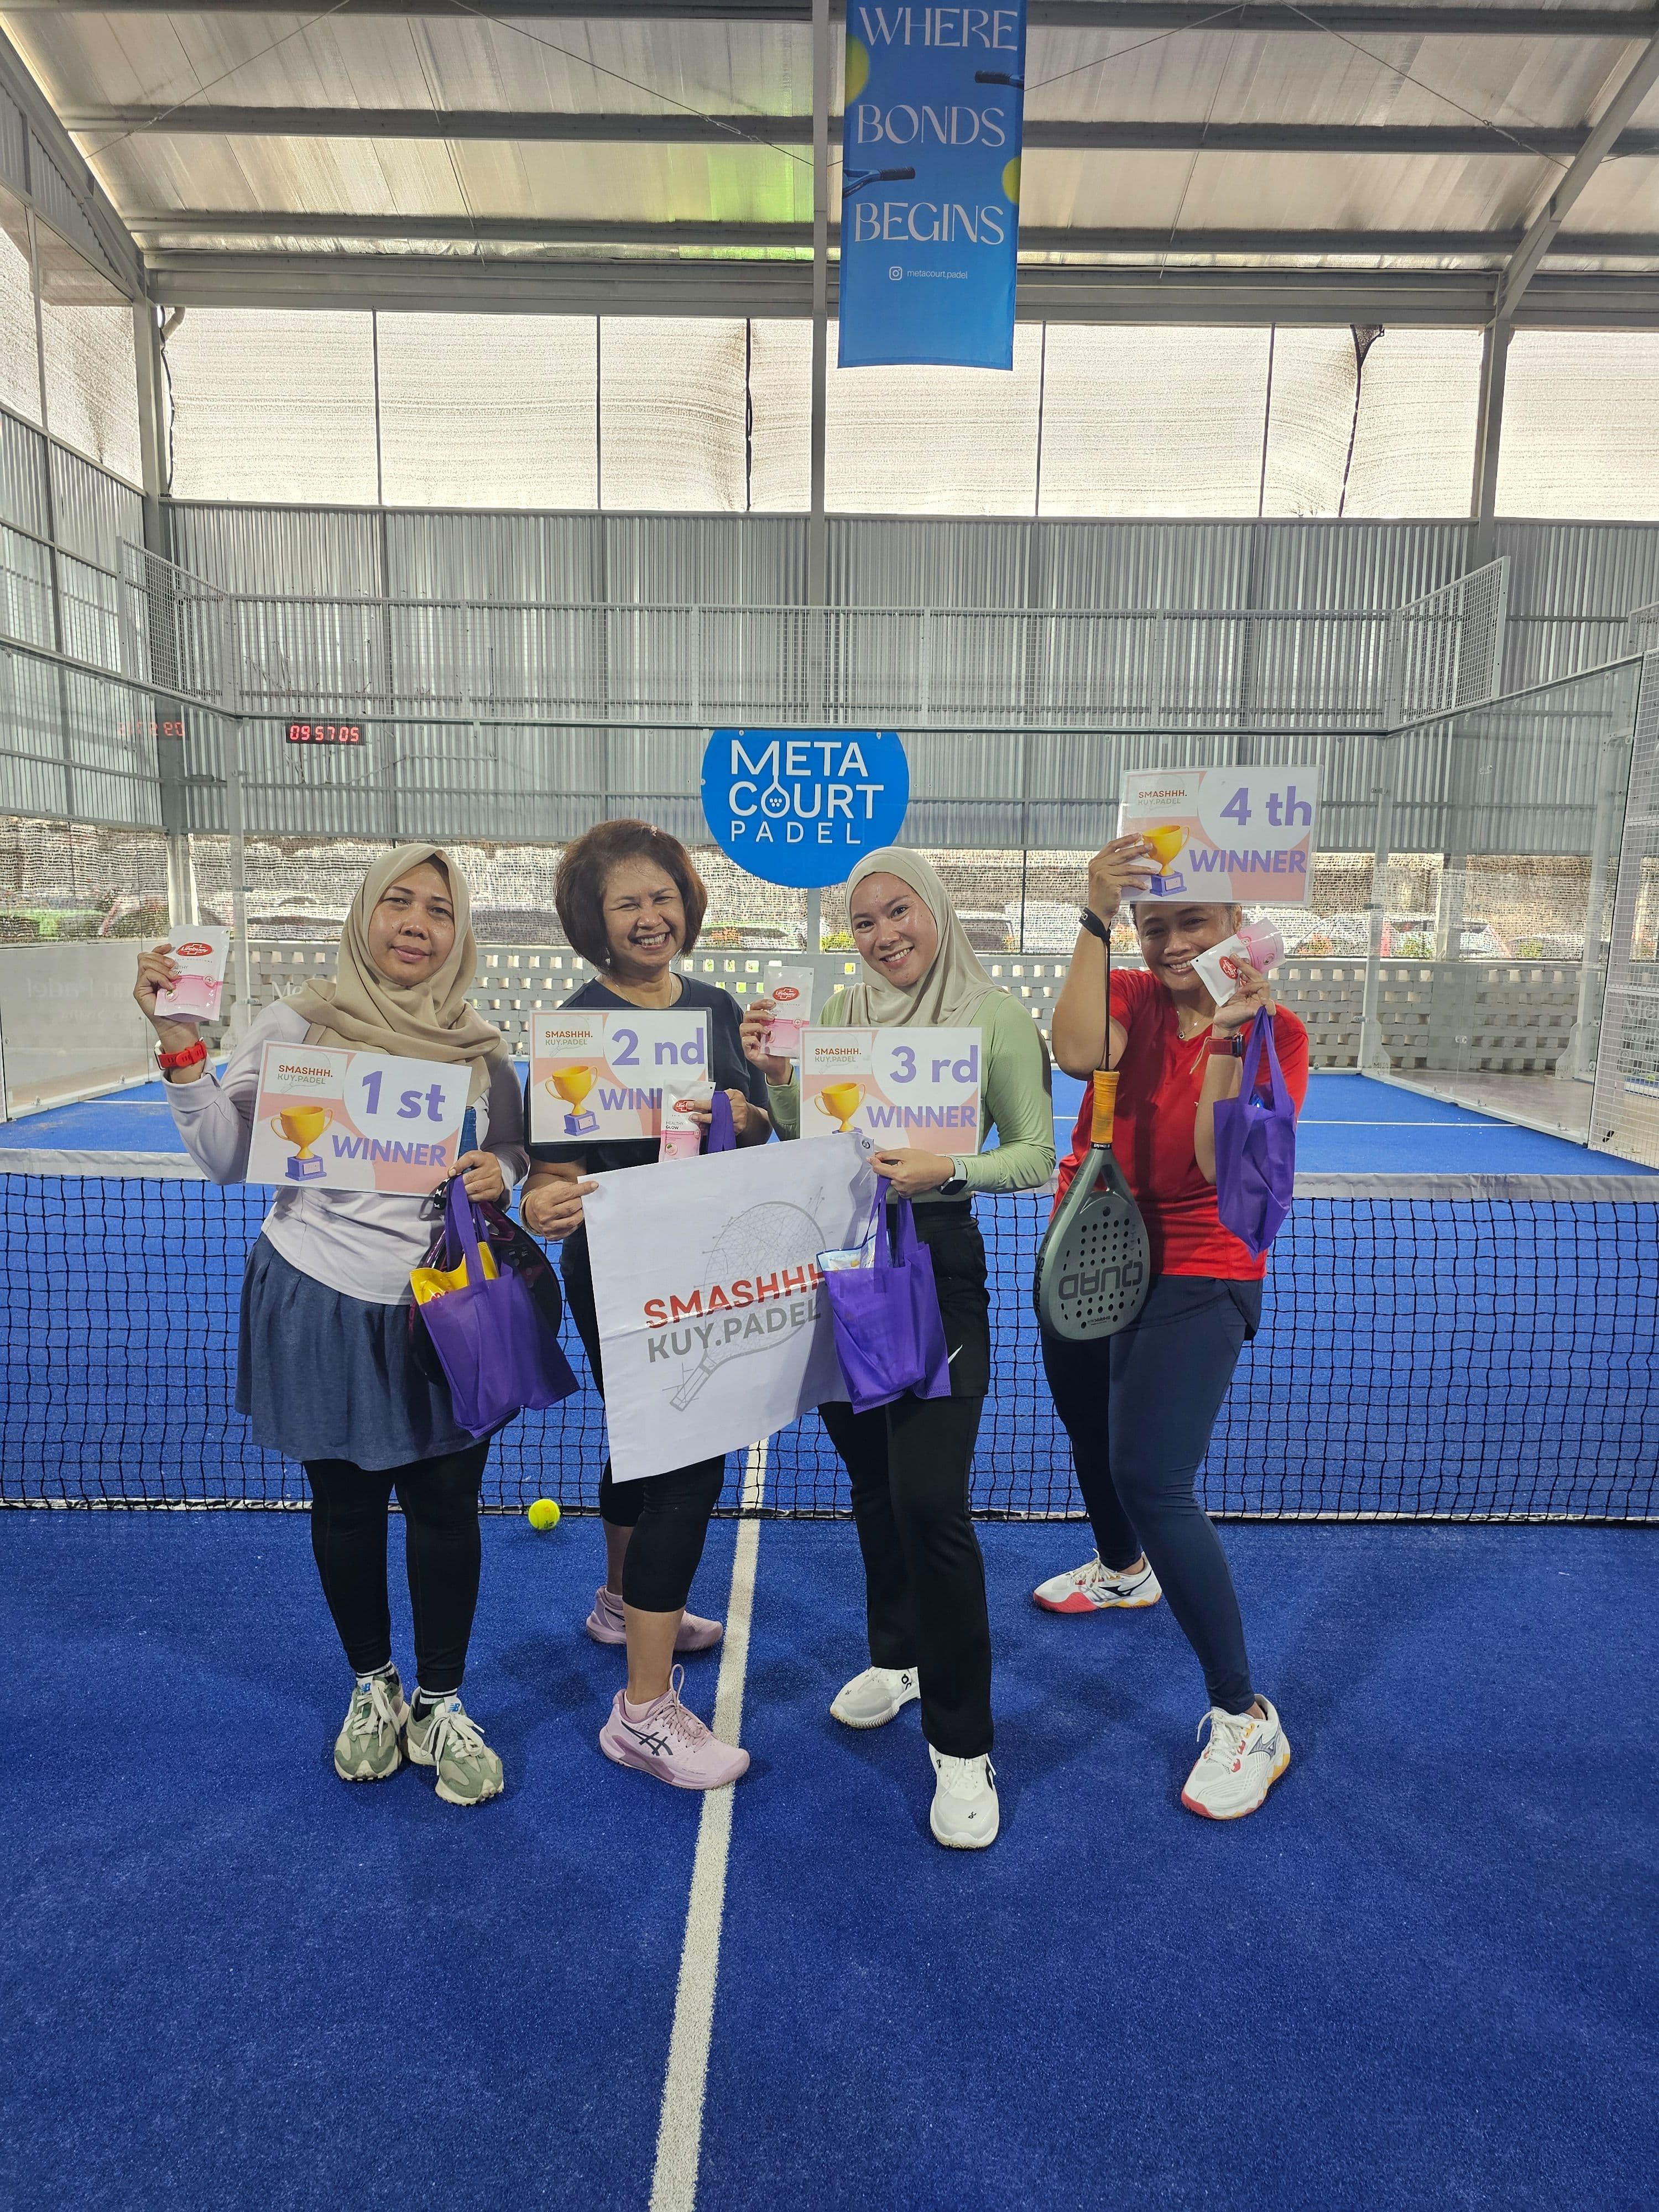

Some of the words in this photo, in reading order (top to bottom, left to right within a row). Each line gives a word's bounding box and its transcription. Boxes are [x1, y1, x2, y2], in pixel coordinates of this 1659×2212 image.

[859, 7, 1018, 51] WHERE
[857, 104, 1005, 147] BONDS
[854, 202, 1004, 245] BEGINS
[907, 270, 968, 279] metacourt.padel
[731, 739, 868, 777] META
[729, 780, 884, 819] COURT
[1139, 789, 1187, 799] SMASHHH.
[1219, 787, 1251, 826] 4
[1265, 785, 1312, 827] th
[731, 820, 860, 844] PADEL
[1189, 849, 1306, 873] WINNER
[612, 1029, 640, 1066] 2
[655, 1027, 705, 1065] nd
[890, 1046, 916, 1083] 3
[932, 1045, 978, 1083] rd
[277, 1073, 326, 1084] KUY.PADEL
[279, 1065, 333, 1077] SMASHHH.
[362, 1071, 383, 1114] 1
[397, 1084, 446, 1122] st
[598, 1088, 662, 1110] WIN
[866, 1106, 977, 1128] WINNER
[332, 1135, 447, 1167] WINNER
[1058, 1260, 1143, 1301] QUAD
[647, 1299, 821, 1363] KUY.PADEL
